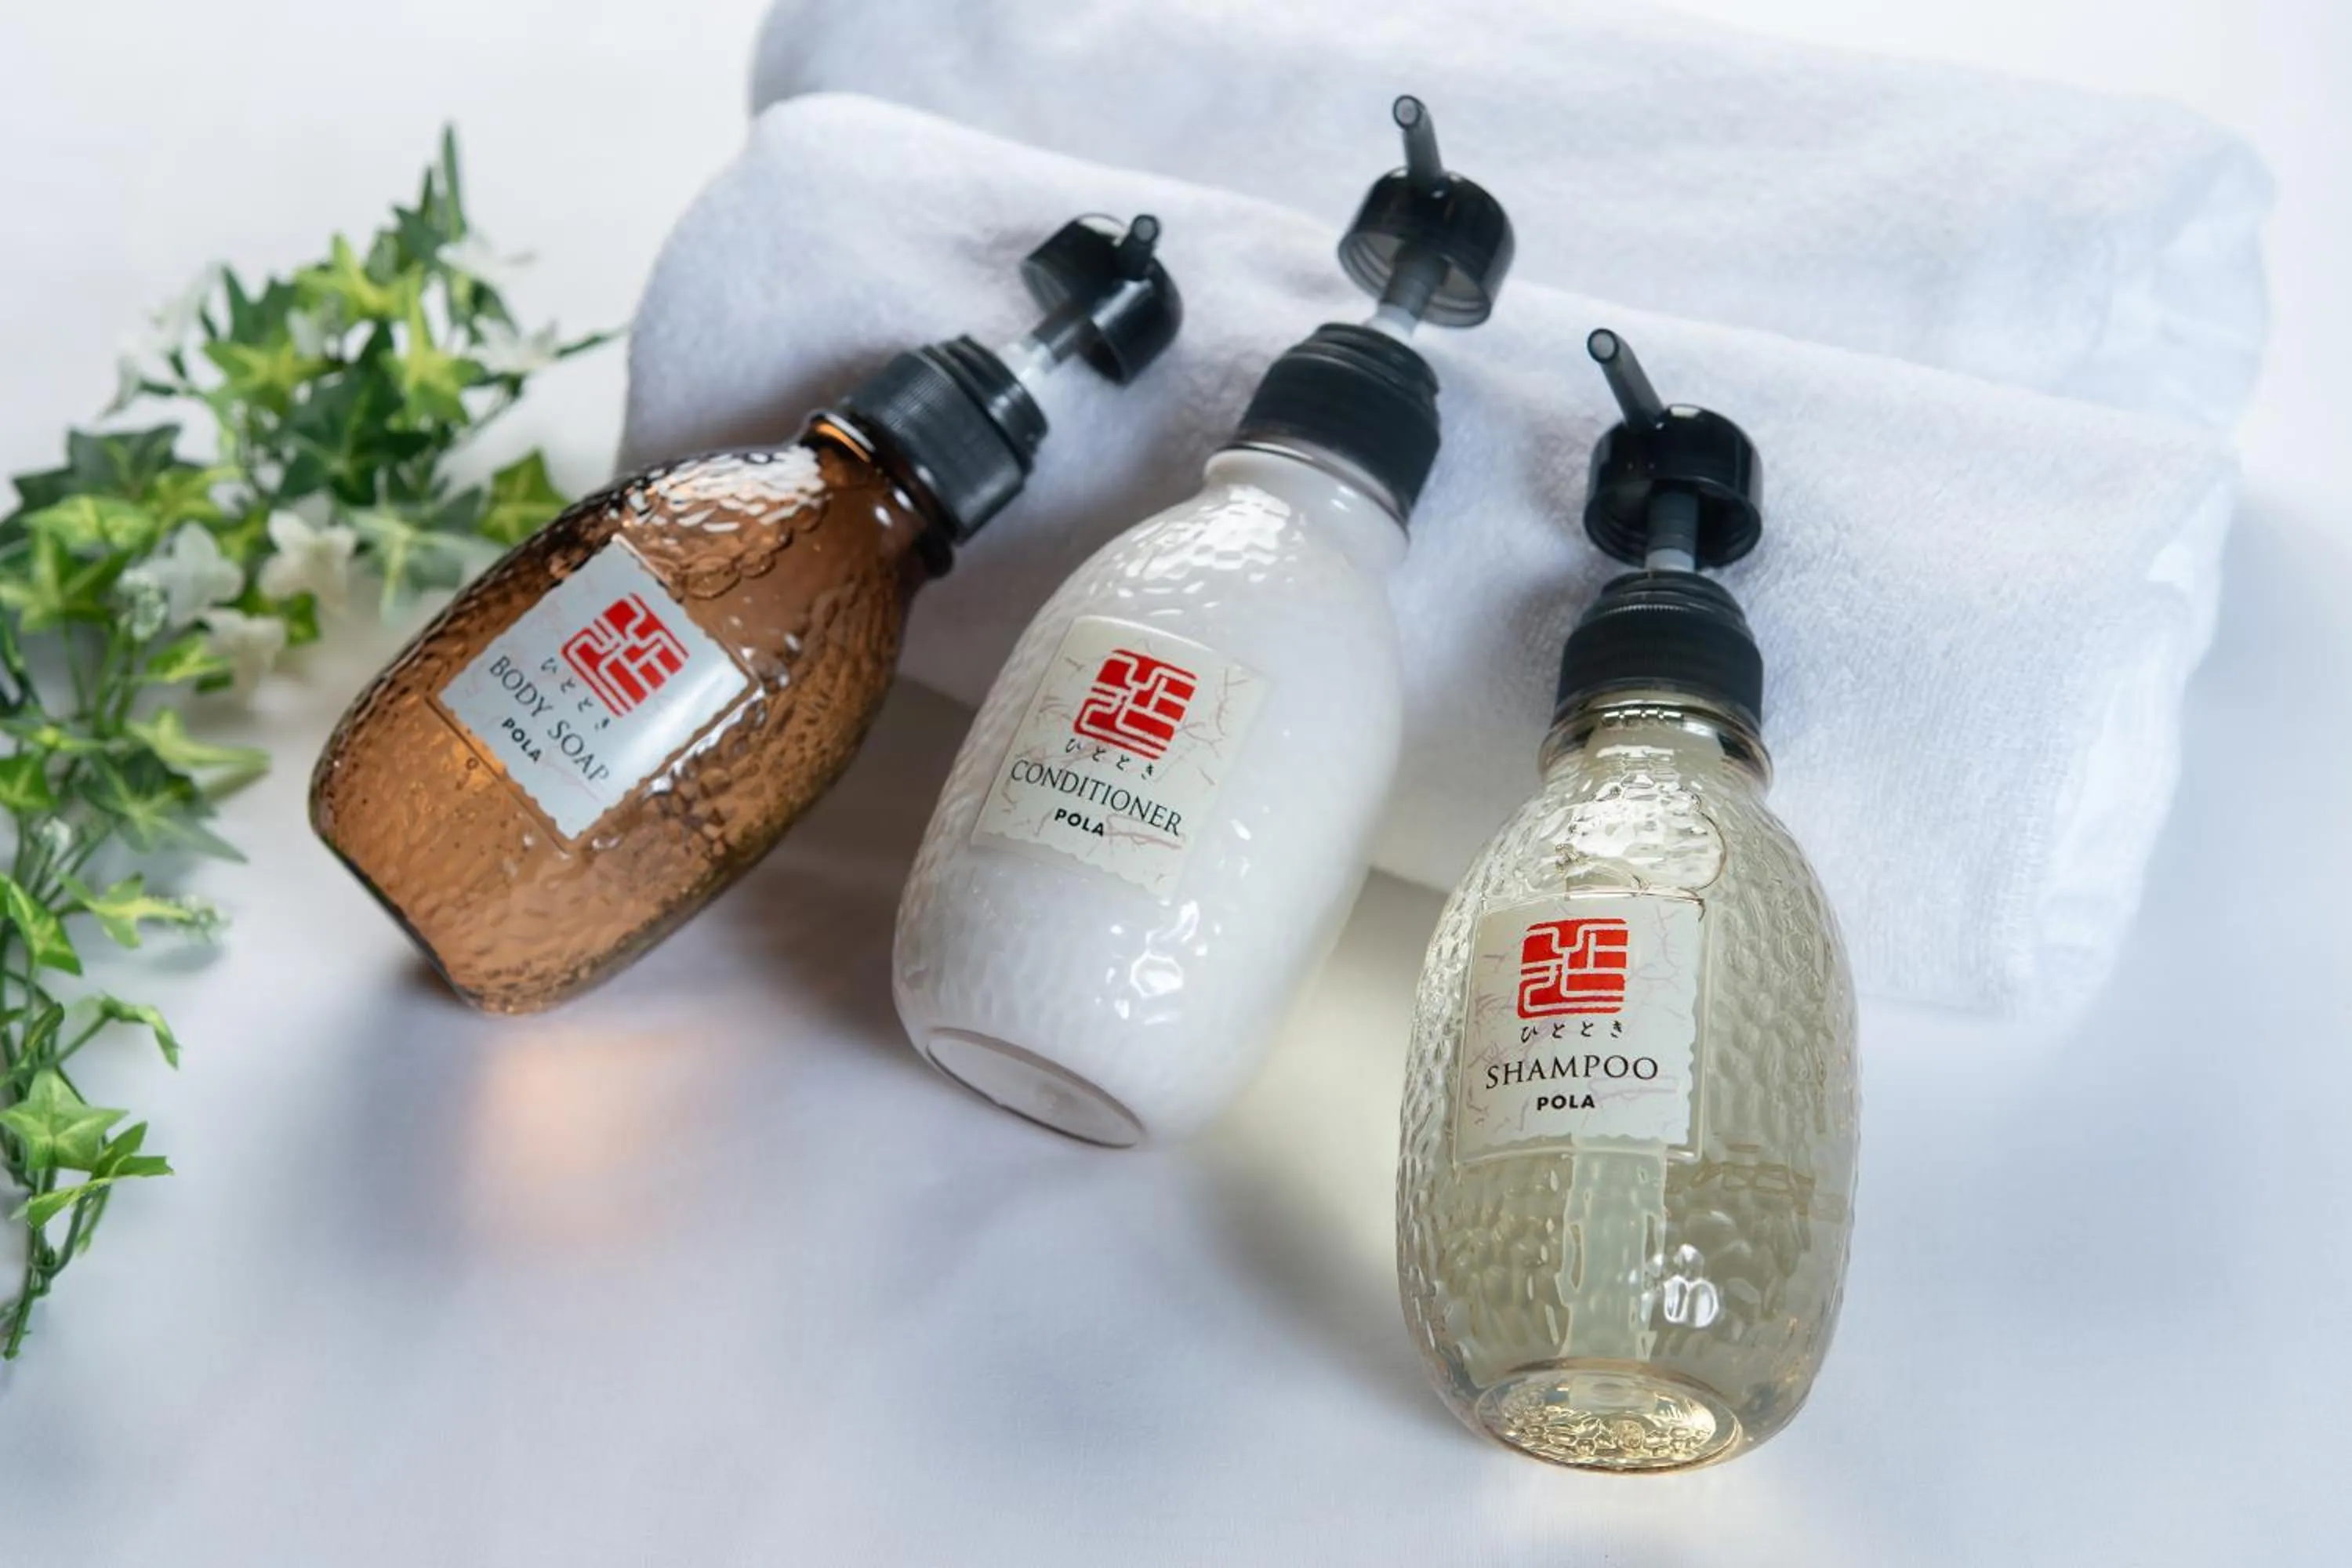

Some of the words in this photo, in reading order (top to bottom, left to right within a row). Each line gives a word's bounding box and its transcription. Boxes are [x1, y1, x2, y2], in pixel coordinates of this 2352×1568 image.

[489, 655, 554, 718] BODY
[547, 720, 610, 782] SOAP
[502, 717, 543, 762] POLA
[1011, 760, 1182, 837] CONDITIONER
[1054, 808, 1105, 837] POLA
[1486, 1054, 1658, 1089] SHAMPOO
[1537, 1094, 1595, 1111] POLA
